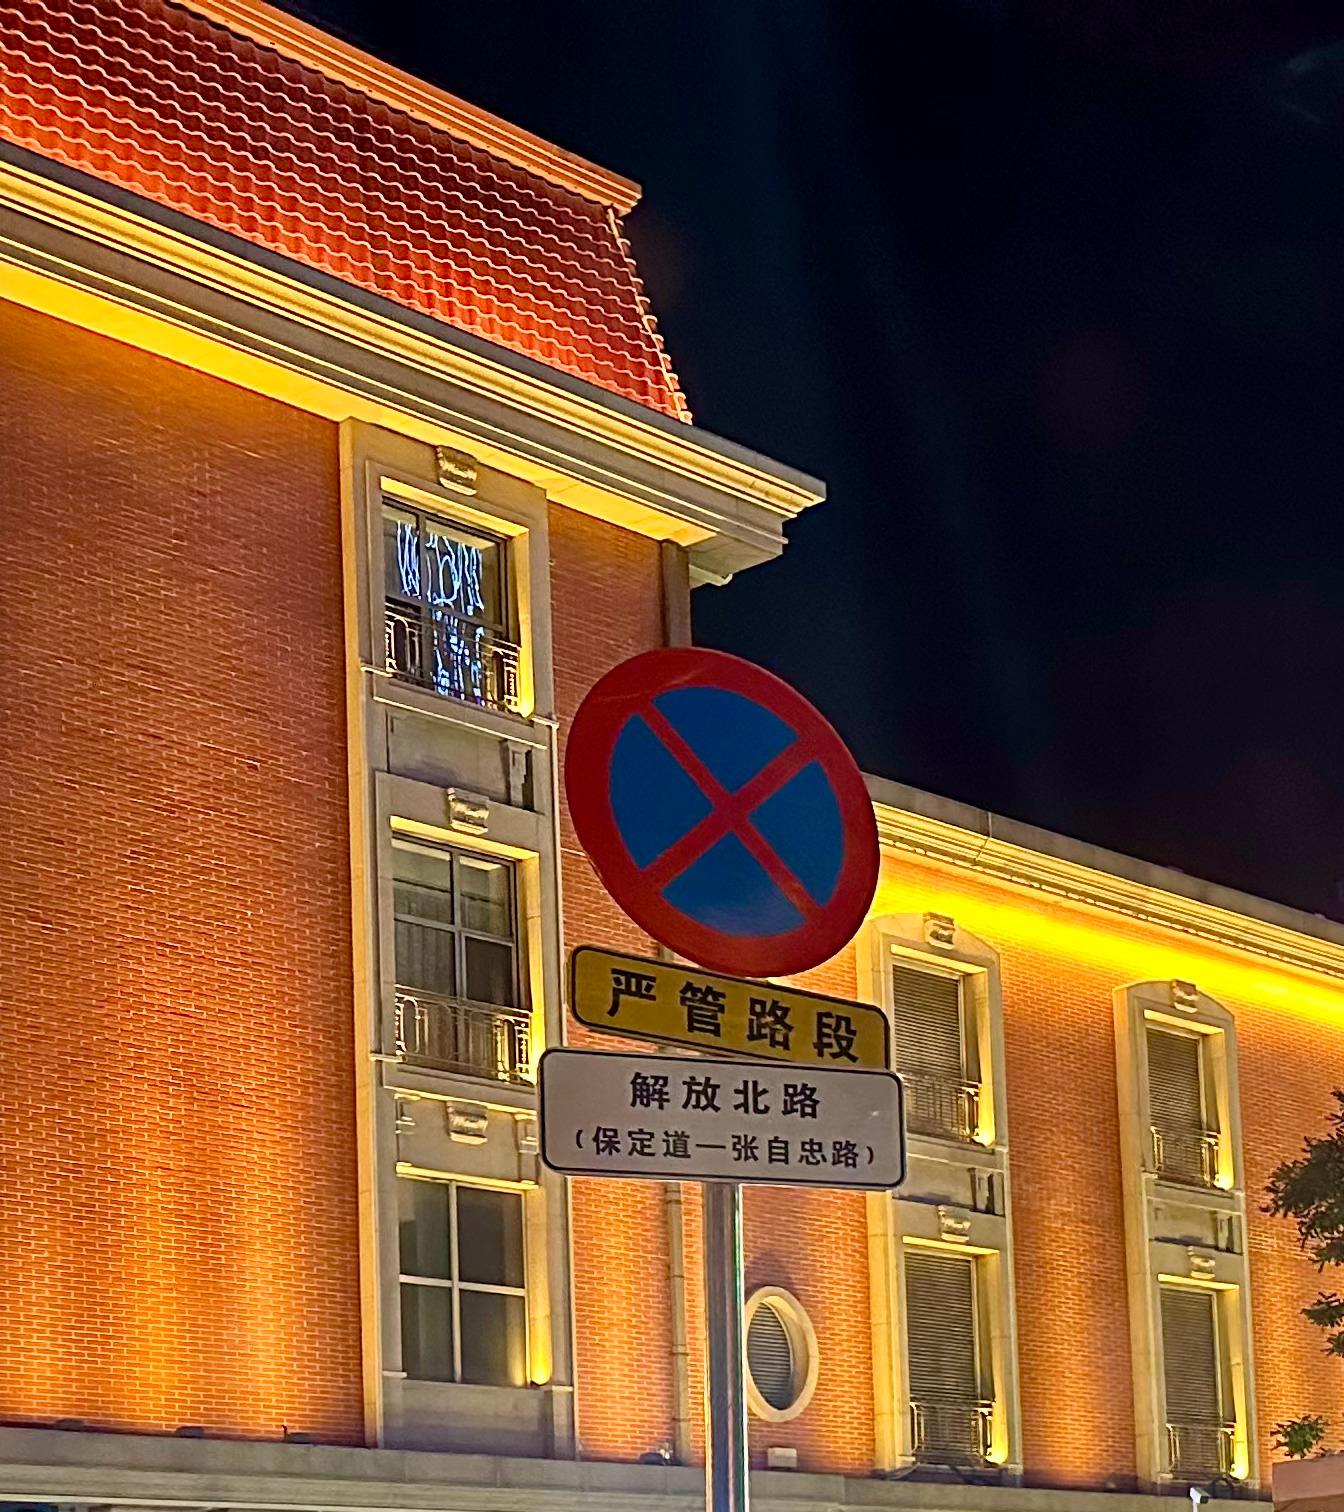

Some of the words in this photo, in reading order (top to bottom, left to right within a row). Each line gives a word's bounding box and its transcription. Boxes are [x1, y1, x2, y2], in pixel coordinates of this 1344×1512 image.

[606, 967, 860, 1063] 严管路段
[629, 1071, 821, 1119] 解放北路
